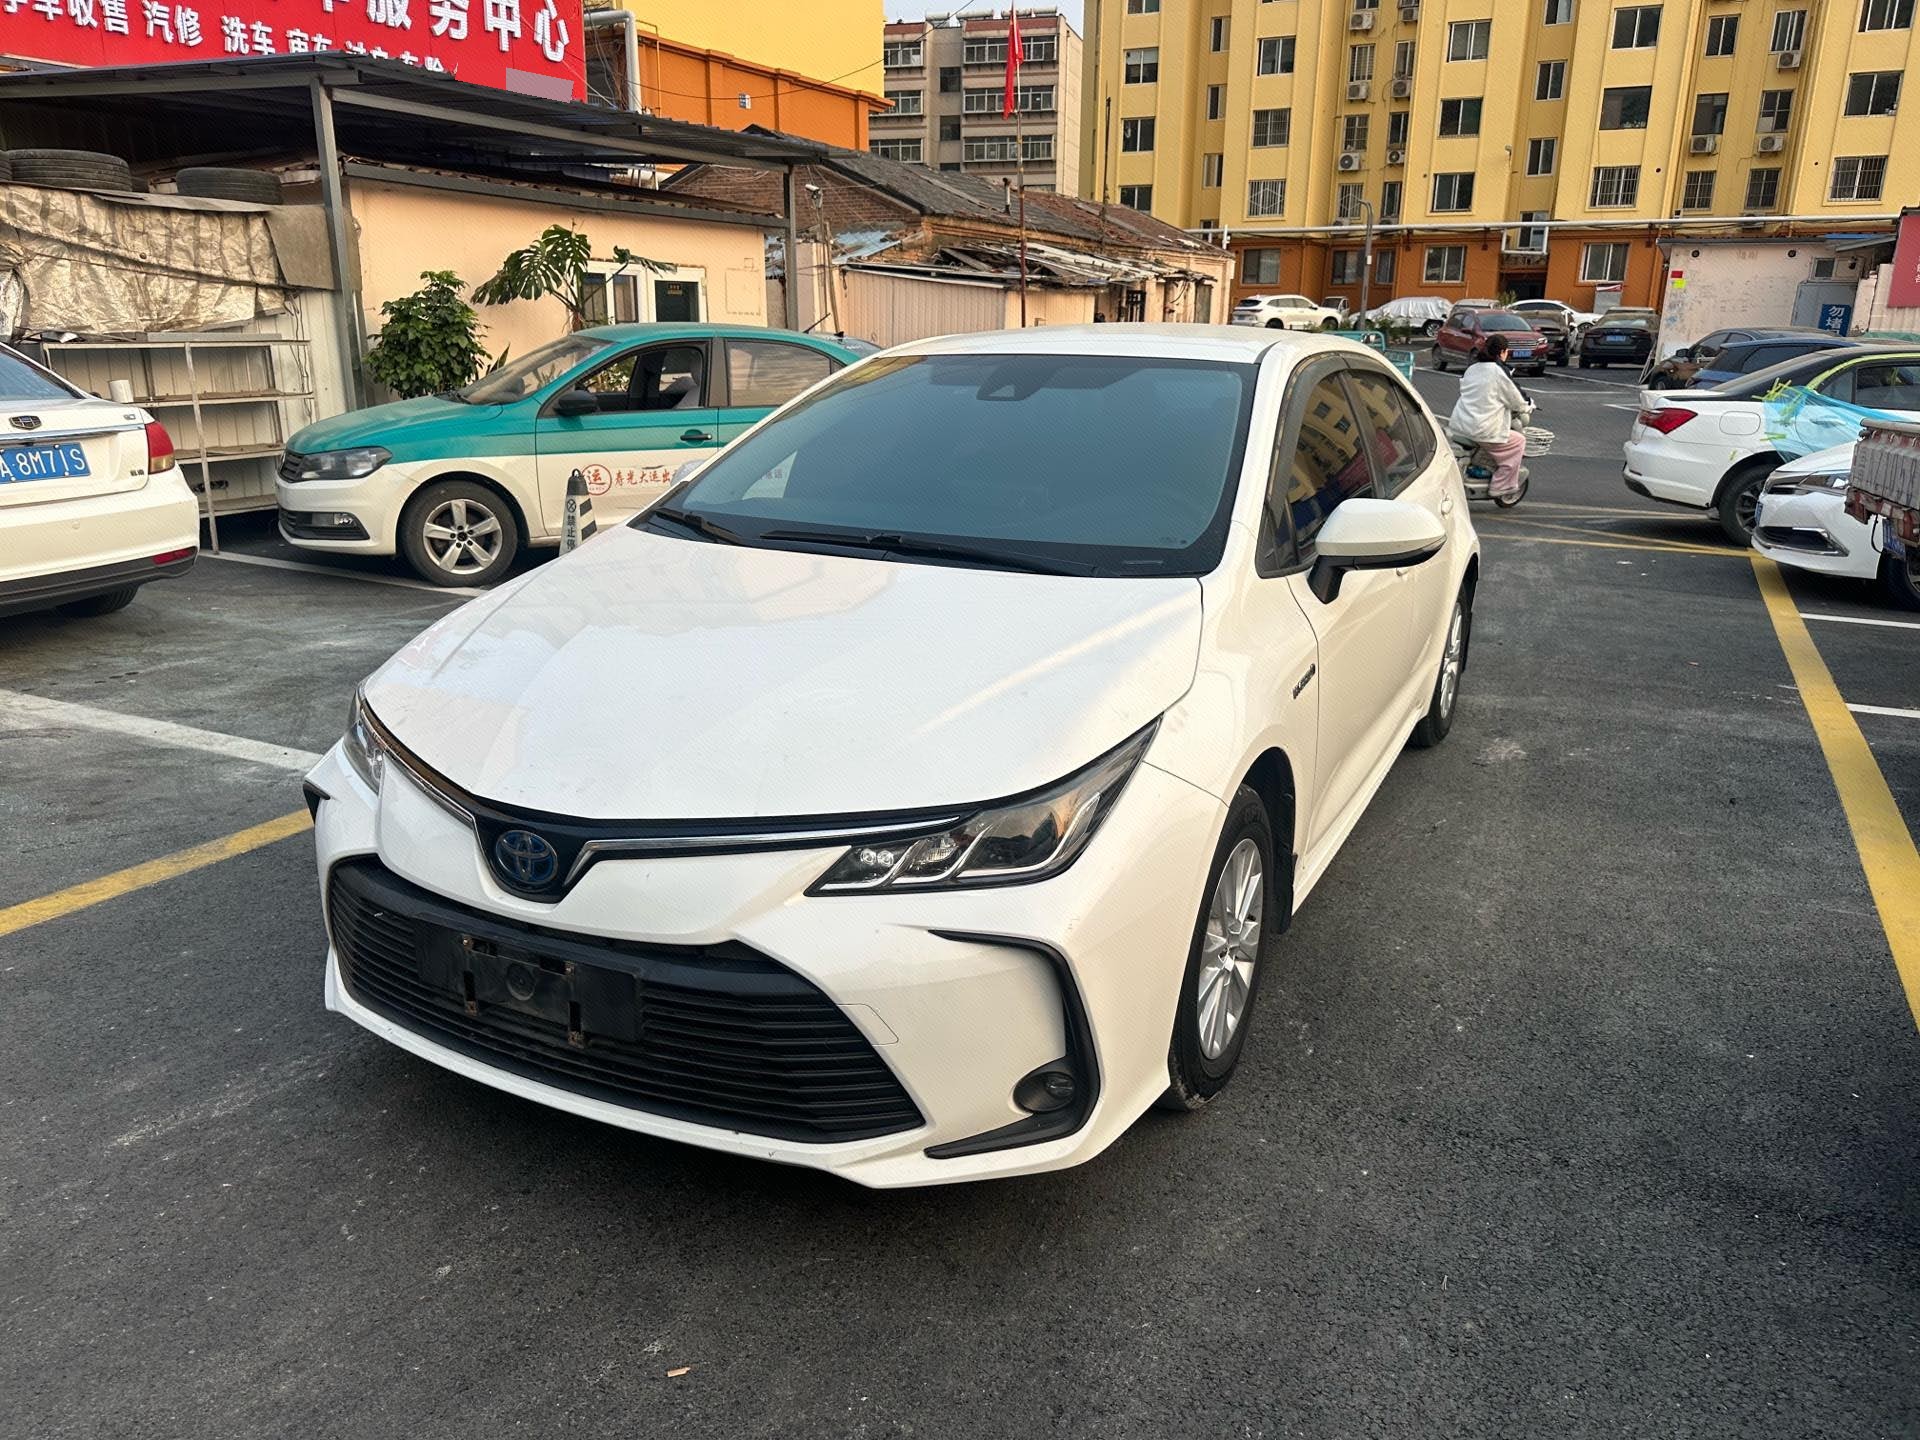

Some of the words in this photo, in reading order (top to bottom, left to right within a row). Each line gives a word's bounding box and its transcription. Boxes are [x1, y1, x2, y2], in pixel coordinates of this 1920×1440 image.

[142, 0, 204, 47] 汽修
[221, 15, 276, 56] 洗车
[316, 0, 571, 62] 服务中心
[615, 469, 677, 487] 寿光大运出
